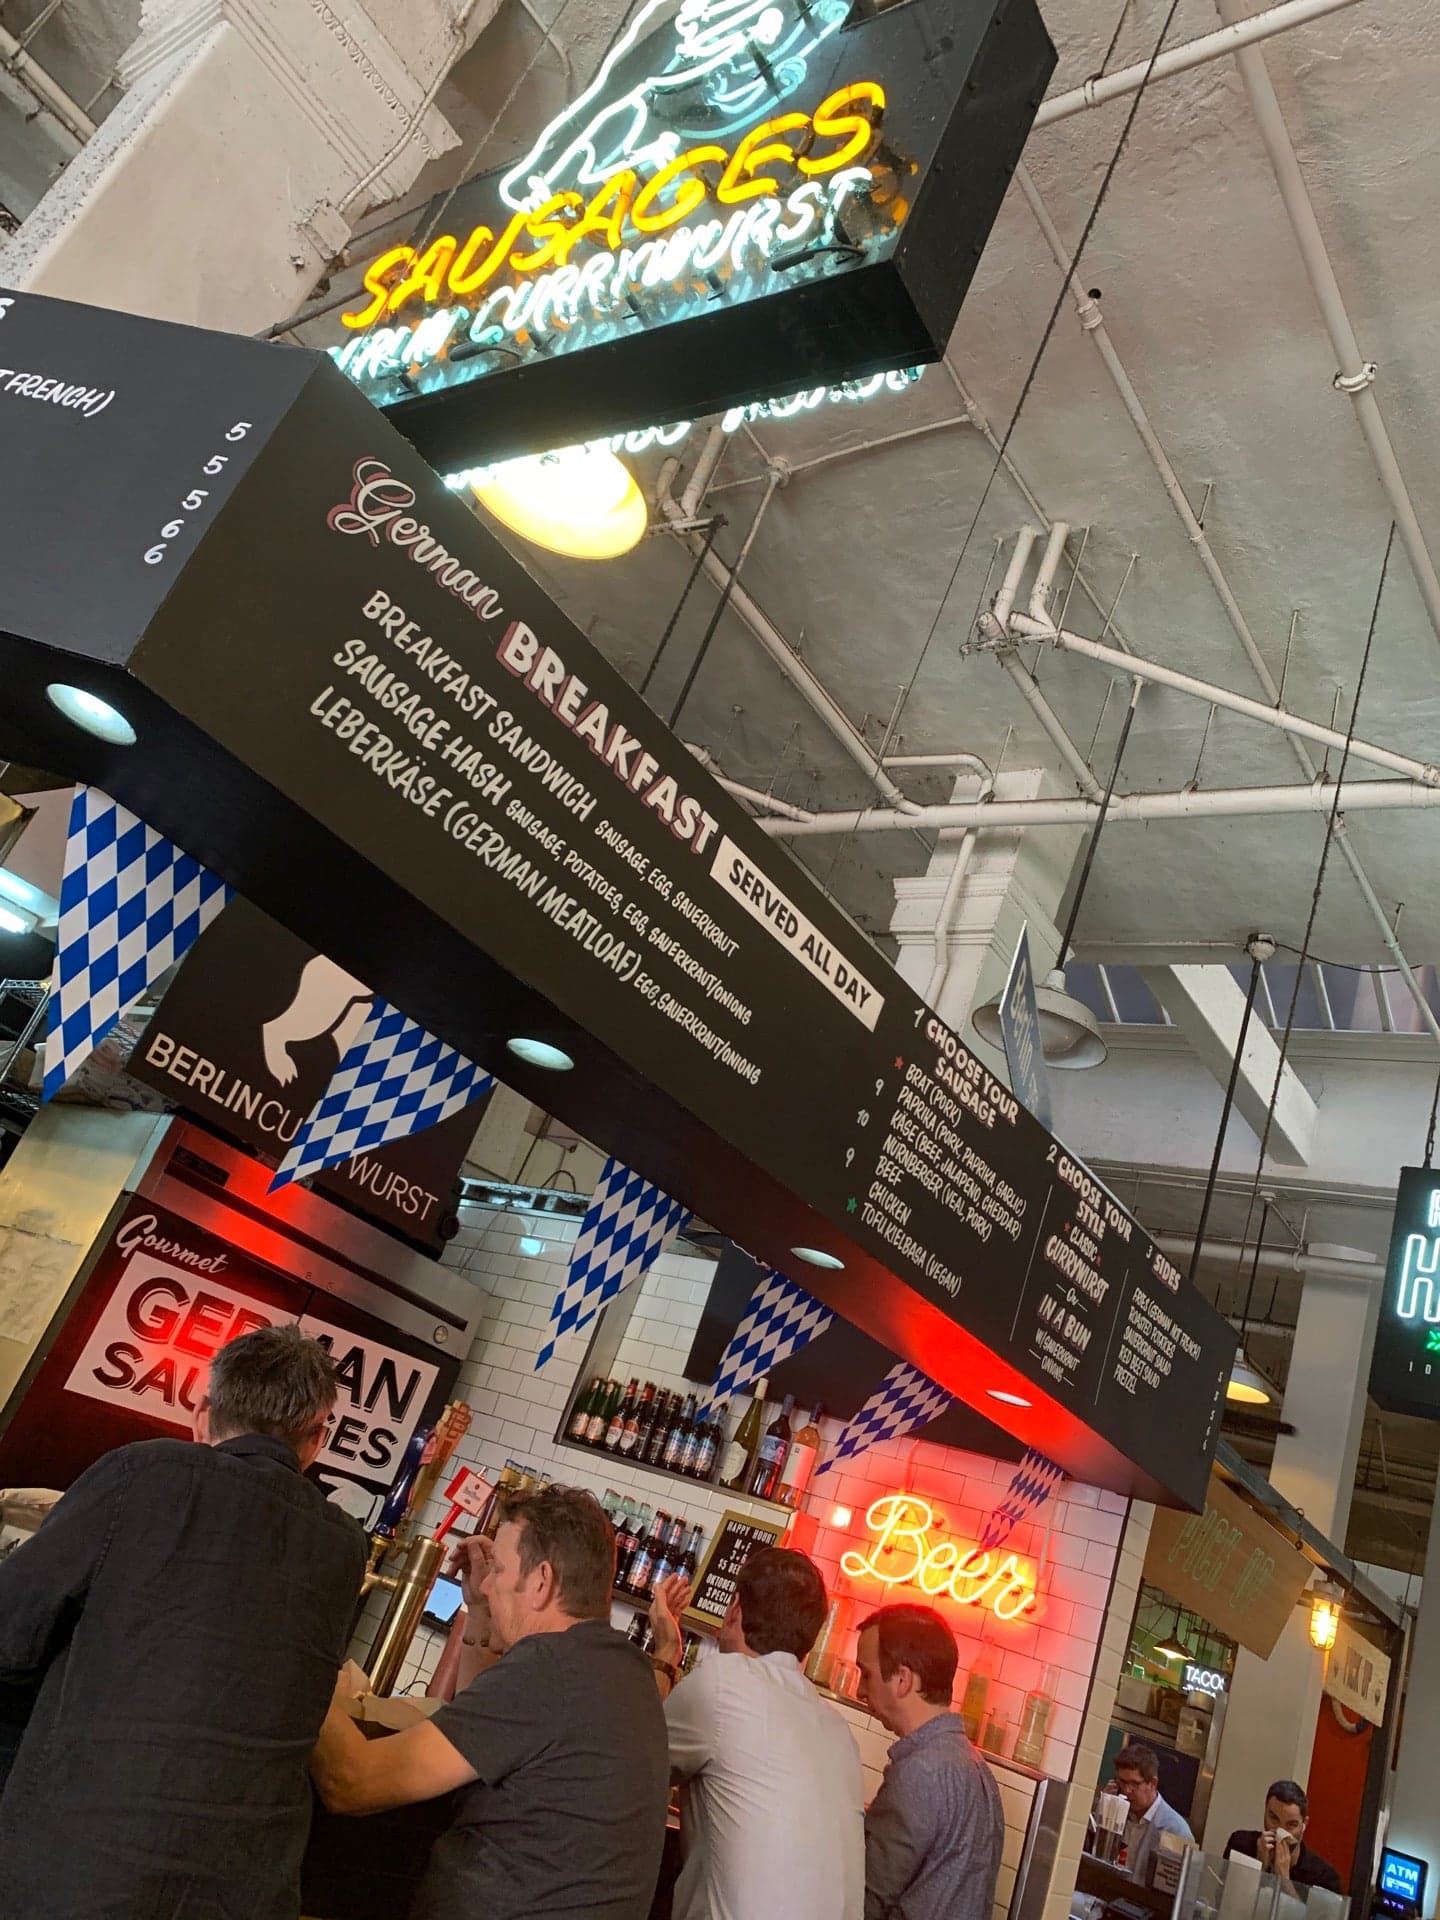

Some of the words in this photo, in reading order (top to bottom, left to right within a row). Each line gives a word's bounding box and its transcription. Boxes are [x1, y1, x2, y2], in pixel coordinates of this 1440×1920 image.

[341, 81, 885, 329] SAUSAGES
[4, 373, 115, 417] FRENCH)
[225, 422, 252, 441] 5
[203, 455, 229, 475] 5
[161, 519, 184, 538] 6
[182, 489, 209, 510] 5
[144, 543, 167, 564] 6
[327, 456, 504, 620] German
[497, 620, 720, 853] BREAKFAST
[362, 590, 499, 720] BREAKFAST
[488, 710, 599, 822] SANDWICH
[594, 819, 648, 881] SAUSAGE,
[648, 866, 673, 902] EGG,
[671, 891, 740, 959] SAUERKRAUT
[309, 685, 451, 818] LEBERKÄSE
[442, 801, 548, 898] (GERMAN
[536, 885, 642, 982] MEATLOAF)
[333, 639, 451, 752] SAUSAGE
[440, 735, 512, 807] HASH
[505, 799, 564, 861] SAUSAGE,
[562, 848, 625, 914] POTATOES,
[622, 902, 648, 937] EGG,
[648, 926, 753, 1026] SAUERKRAUT/ONIONS
[728, 858, 799, 940] SERVED
[800, 933, 832, 977] ALL
[833, 963, 873, 1010] DAY
[875, 1078, 885, 1097] 9
[905, 1063, 934, 1095] BRAT
[930, 1085, 962, 1128] (PORK)
[914, 1007, 925, 1029] 1
[926, 1018, 983, 1087] CHOOSE
[980, 1072, 1020, 1125] YOUR
[935, 1056, 997, 1128] SAUSAGE
[856, 1109, 870, 1127] 10
[845, 1147, 855, 1168] 9
[875, 1155, 905, 1186] BEEF
[890, 1107, 919, 1144] KÄSE
[914, 1130, 943, 1169] (BEEF,
[981, 1195, 1022, 1242] CHEDDAR)
[897, 1085, 936, 1132] PAPRIKA
[934, 1121, 960, 1160] (PORK,
[960, 1146, 997, 1194] PAPRIKA,
[994, 1179, 1027, 1217] GARLIC)
[868, 1180, 912, 1226] CHICKEN
[882, 1133, 944, 1199] NÜRNBERGER
[941, 1182, 966, 1223] (VEAL,
[965, 1205, 993, 1243] PORK)
[1046, 1143, 1057, 1164] 2
[1058, 1155, 1103, 1211] CHOOSE
[1103, 1199, 1133, 1243] YOUR
[115, 1213, 230, 1275] Gourmet
[860, 1201, 886, 1235] TOFU
[884, 1223, 927, 1269] KIELBASA
[925, 1253, 962, 1298] (VEGAN)
[1069, 1226, 1098, 1262] CLASSIC
[1076, 1199, 1106, 1241] STYLE
[1045, 1234, 1110, 1305] CURRYWURST
[1153, 1253, 1182, 1295] SIDES
[1037, 1293, 1058, 1323] IN
[1052, 1307, 1066, 1331] A
[1063, 1314, 1092, 1352] BUN
[726, 1520, 750, 1537] HAPPY
[751, 1529, 776, 1546] HOUR!
[840, 1495, 1036, 1620] Beer
[1387, 1863, 1418, 1882] ATM
